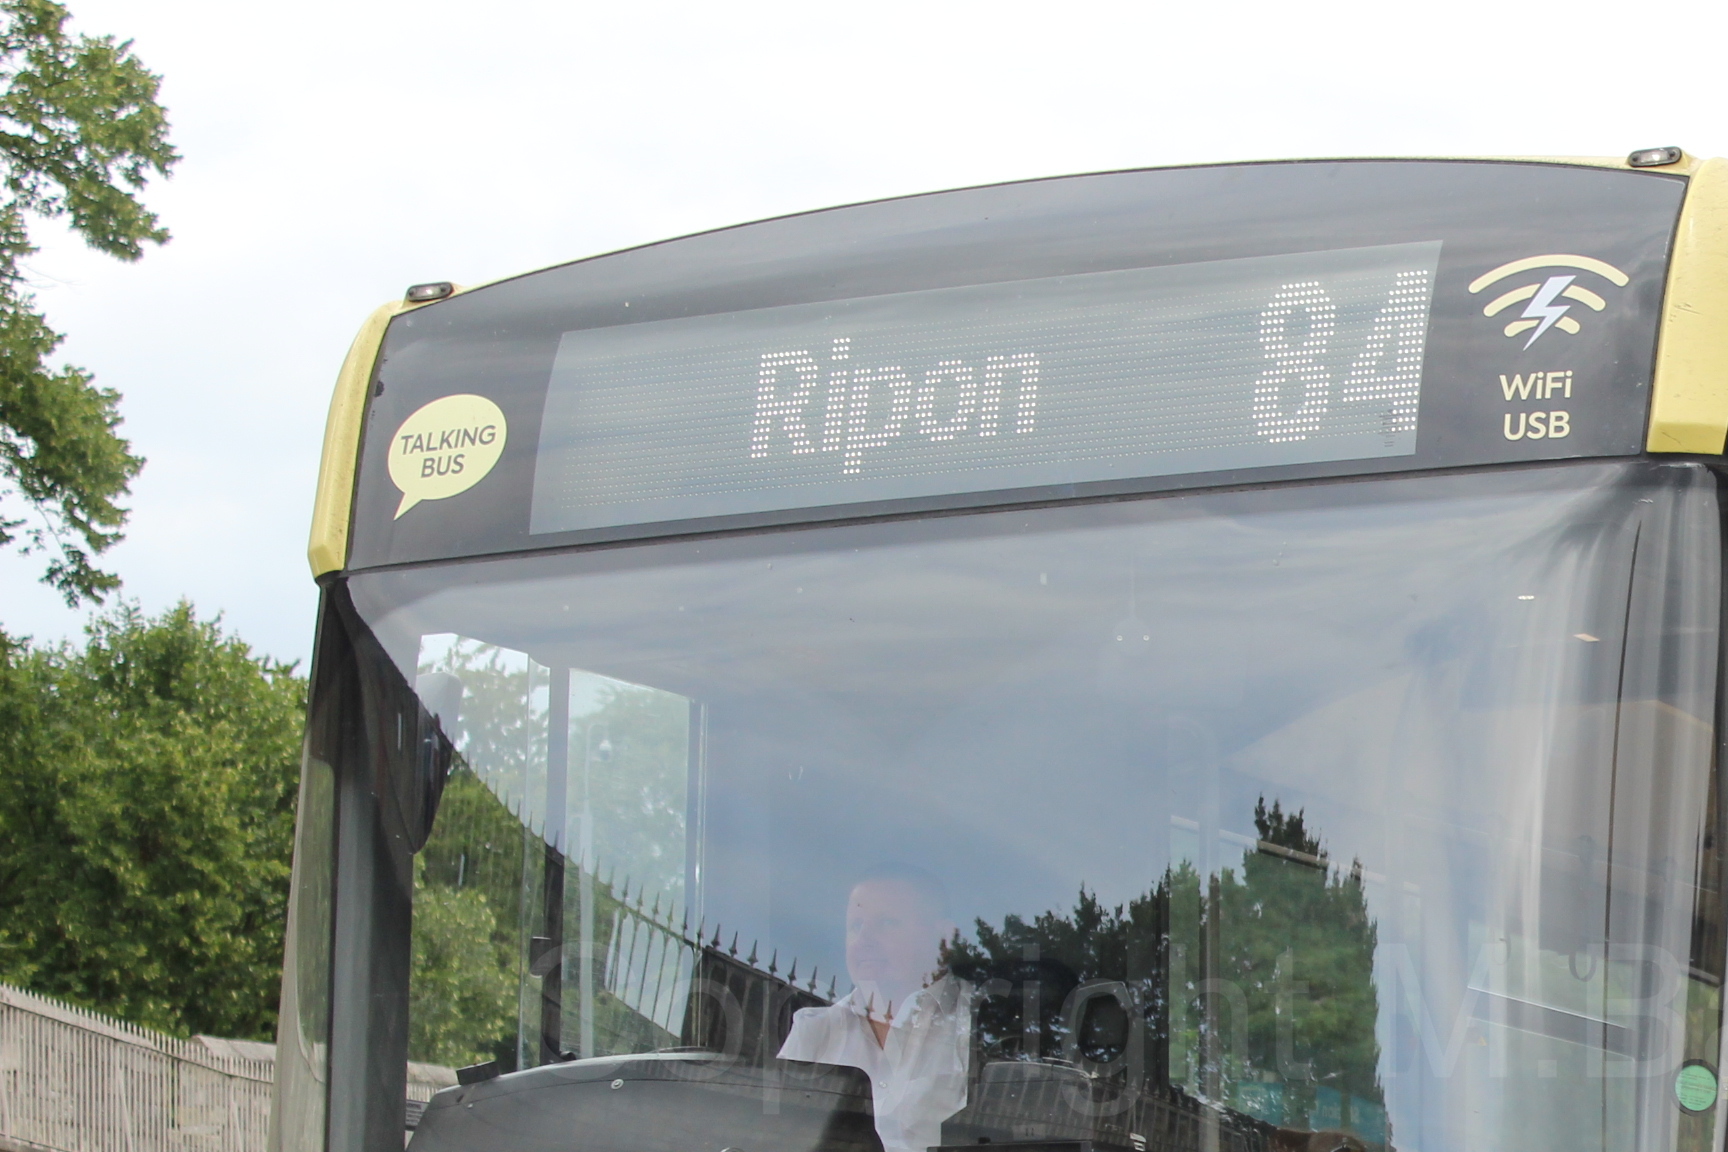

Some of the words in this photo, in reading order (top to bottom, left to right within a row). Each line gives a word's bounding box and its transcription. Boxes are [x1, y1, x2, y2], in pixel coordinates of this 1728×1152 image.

[1253, 269, 1428, 443] 84
[1500, 370, 1573, 402] WiFi
[751, 336, 1040, 475] Ripon
[400, 424, 497, 456] TALKING
[1502, 410, 1571, 441] USB
[420, 453, 466, 479] BUS
